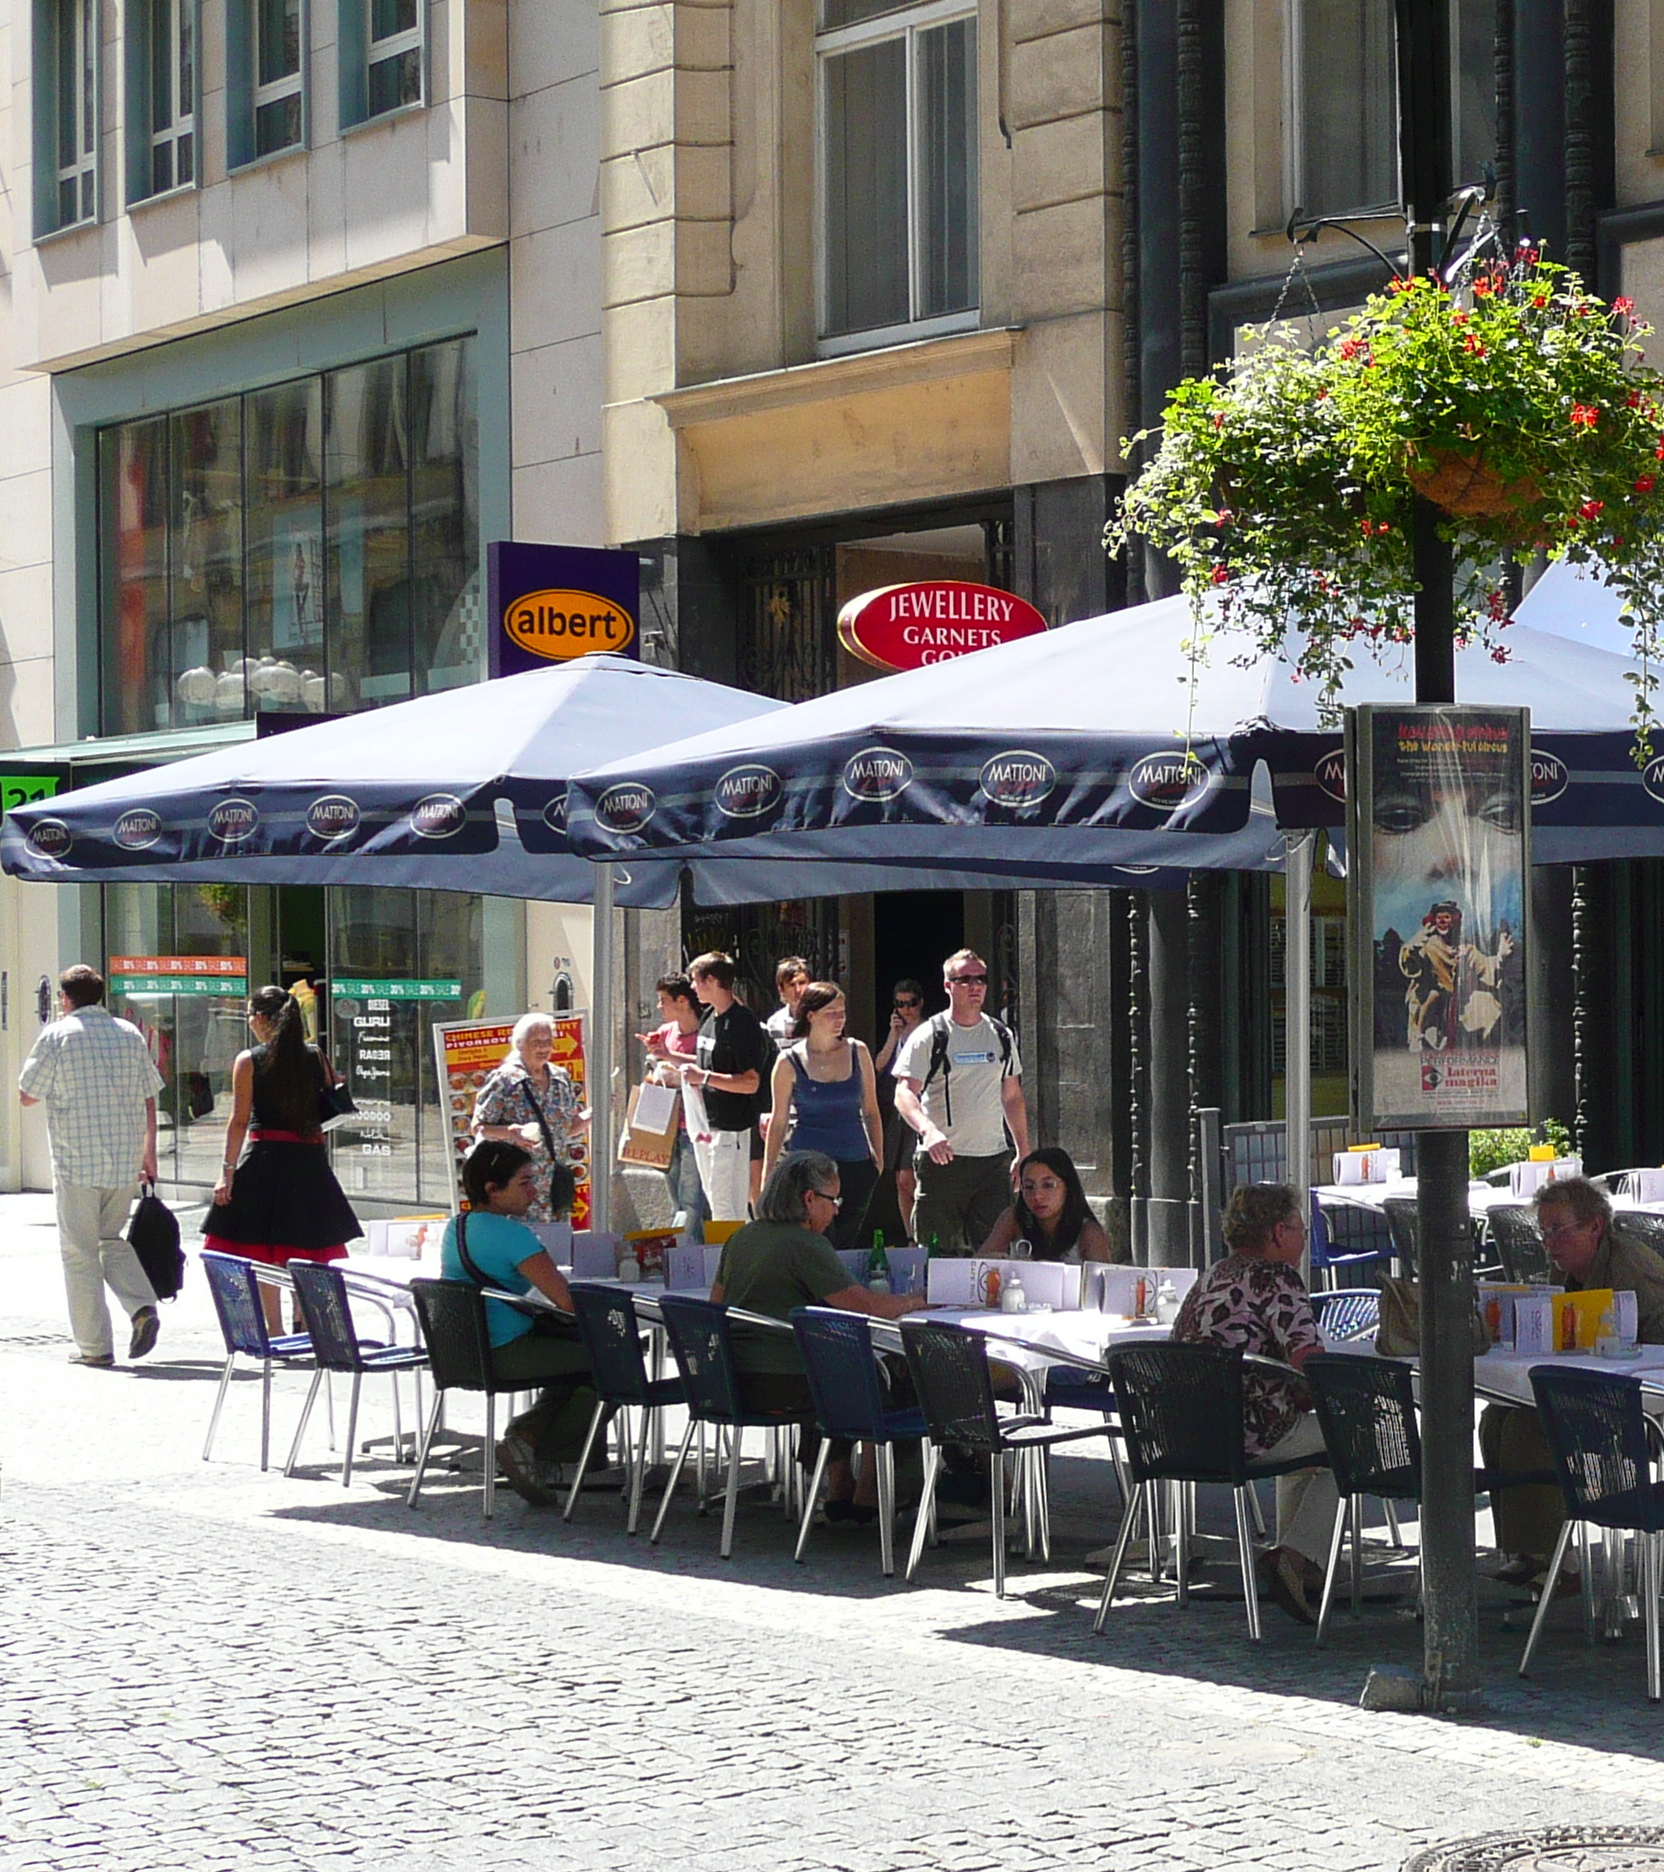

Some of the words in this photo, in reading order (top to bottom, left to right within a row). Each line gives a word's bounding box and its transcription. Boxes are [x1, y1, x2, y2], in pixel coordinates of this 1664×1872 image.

[889, 590, 1014, 622] JEWELLERY
[516, 604, 617, 640] albert
[903, 626, 1001, 647] GARNETS
[1398, 740, 1418, 752] the
[1421, 740, 1476, 752] wonderful
[850, 760, 905, 779] MATTONI
[988, 763, 1047, 783] MATTONI
[722, 776, 773, 798] MATTONI
[313, 803, 354, 820] MATTONI
[416, 803, 459, 820] MATTONI
[603, 794, 648, 813] MATTONI
[213, 807, 254, 824] MATTONI
[118, 818, 157, 833] MATTONI
[33, 827, 67, 844] MATTONI
[354, 1016, 390, 1027] GURU
[445, 1031, 494, 1042] CHINESE
[1447, 1066, 1497, 1077] laterna
[1445, 1077, 1498, 1089] magika
[352, 1111, 391, 1122] OODOO
[362, 1144, 391, 1156] GAS
[623, 1147, 669, 1164] REPLAY
